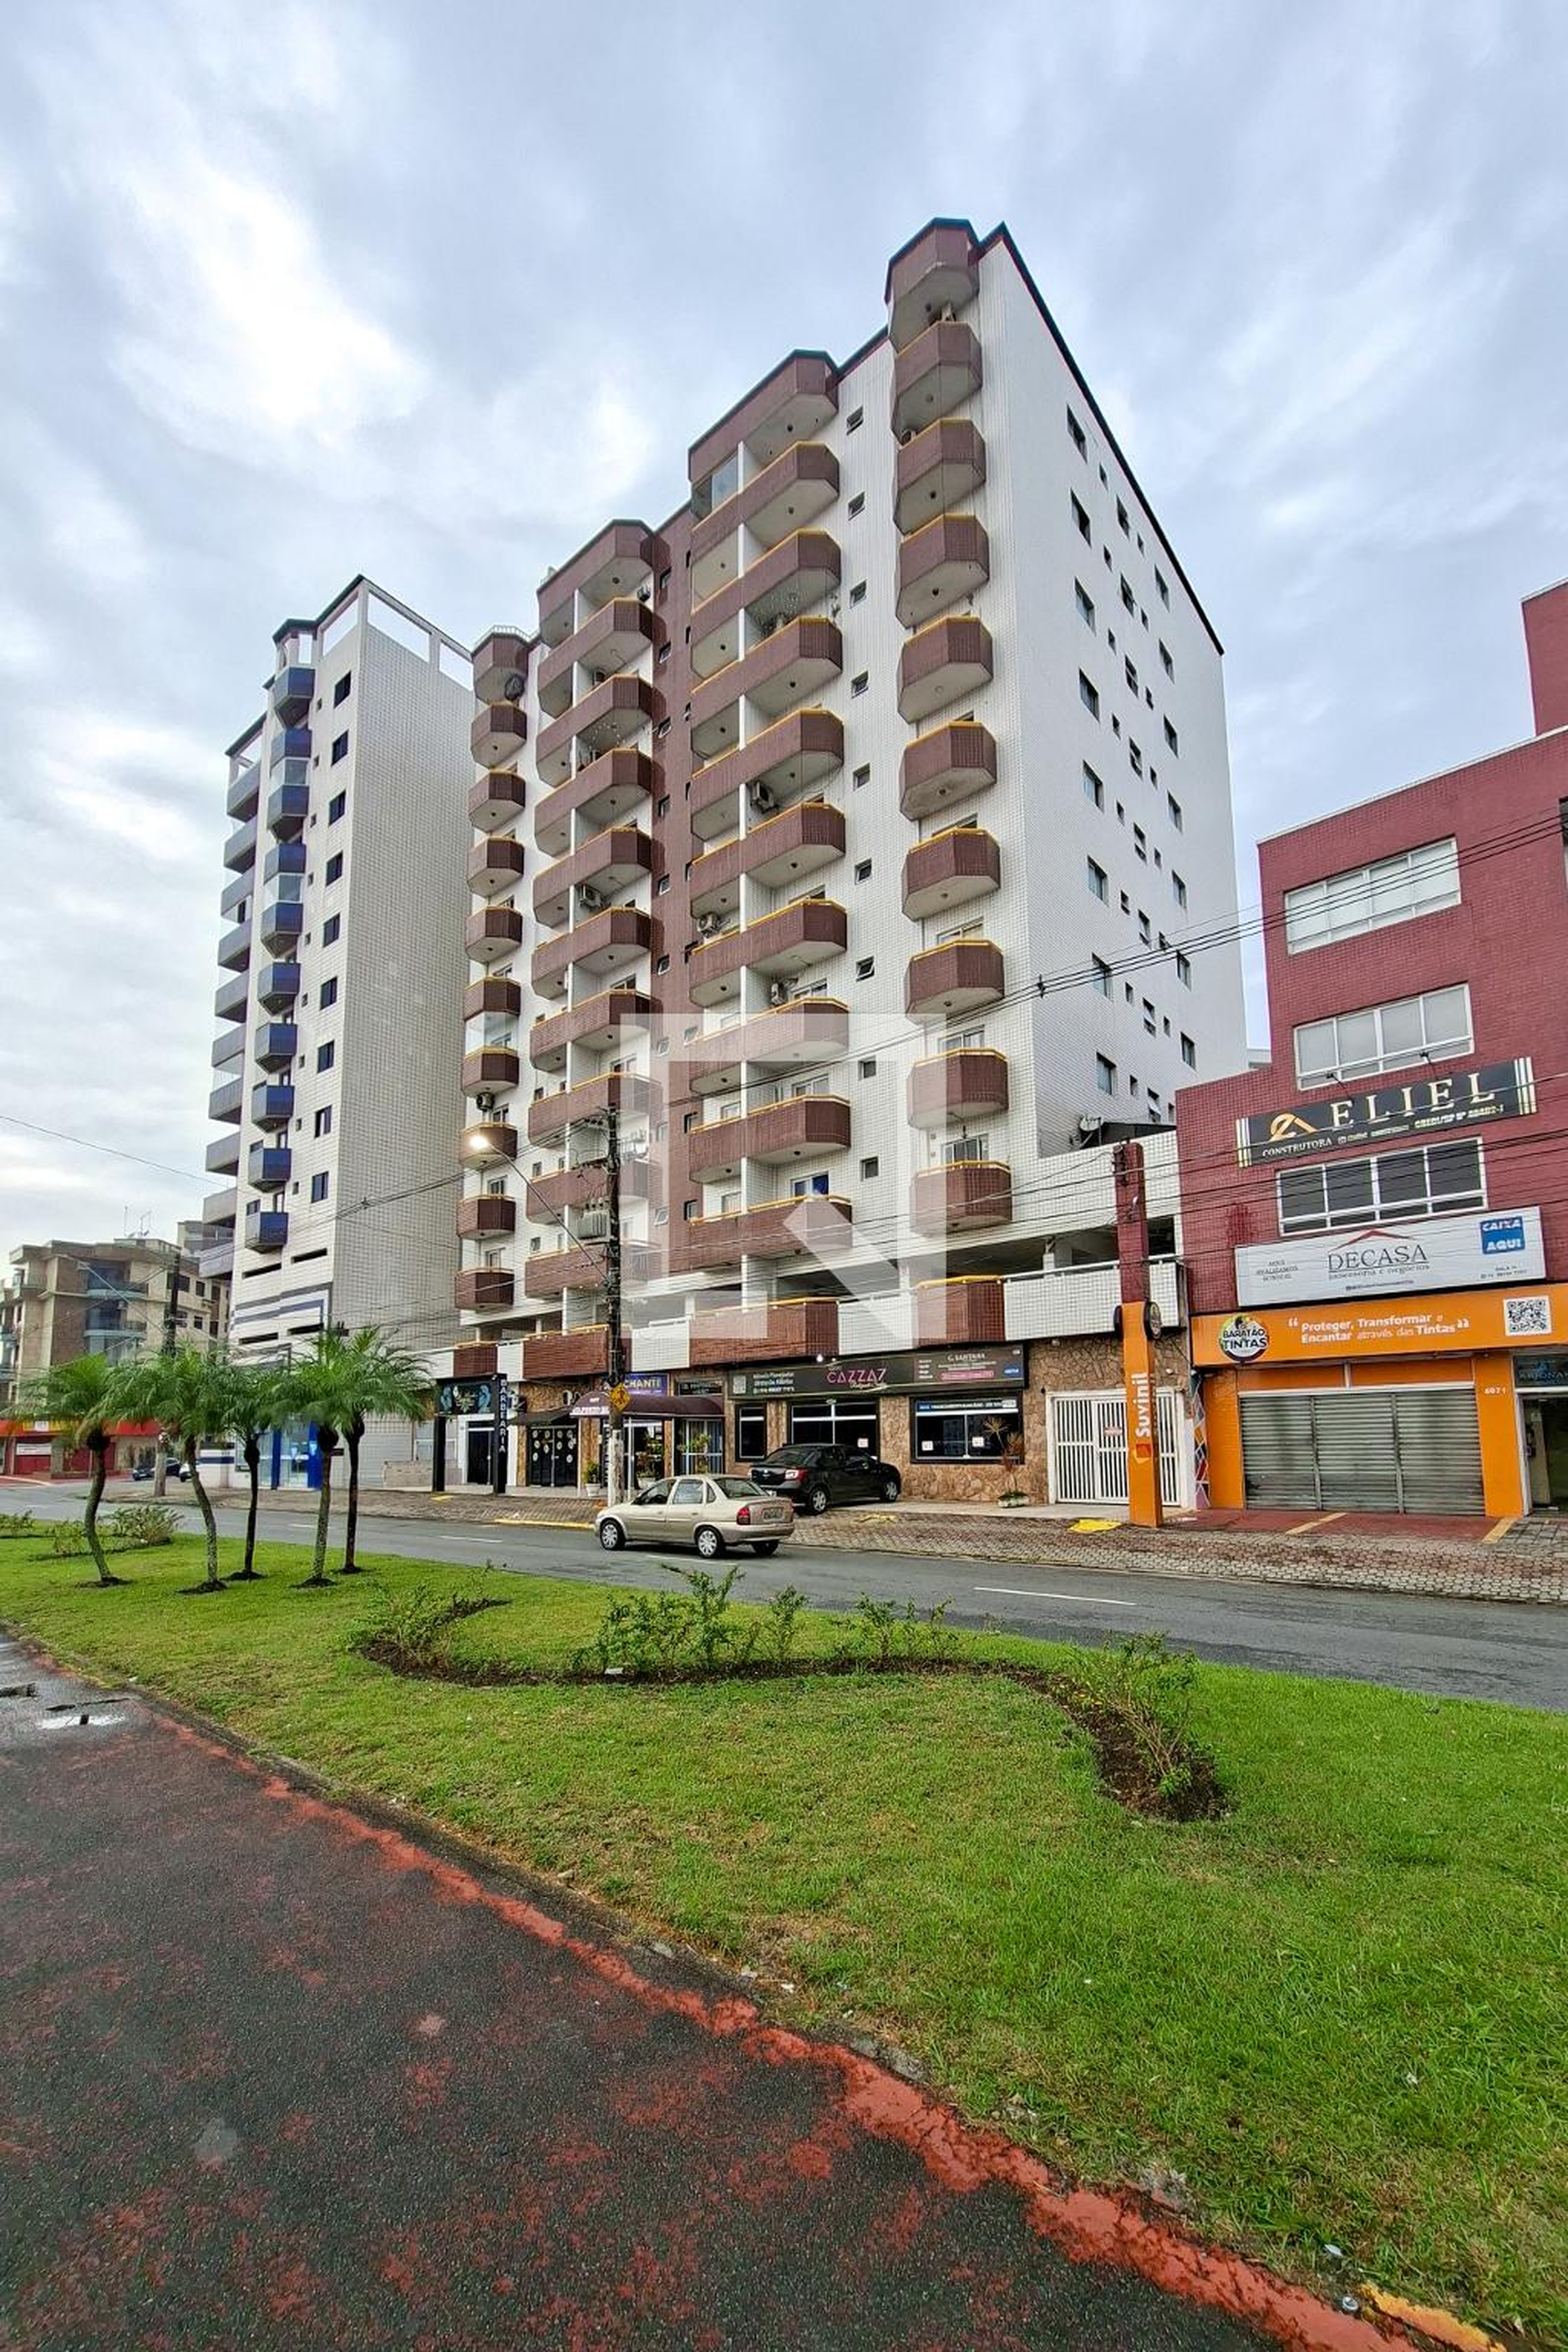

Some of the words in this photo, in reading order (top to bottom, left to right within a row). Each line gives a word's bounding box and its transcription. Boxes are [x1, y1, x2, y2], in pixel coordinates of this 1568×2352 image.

[1330, 1072, 1495, 1131] ELIEL
[1262, 1136, 1333, 1157] CONSTRUTORA
[1482, 1219, 1521, 1232] CAIXA
[1486, 1238, 1522, 1251] AQUI
[1327, 1244, 1428, 1271] DECASA
[1223, 1325, 1265, 1338] BARATÃO
[1357, 1314, 1432, 1328] Transformar
[1223, 1337, 1267, 1350] TINTAS
[1301, 1331, 1352, 1344] Encantar
[1396, 1325, 1414, 1337] das
[1415, 1323, 1456, 1335] Tintas
[1131, 1372, 1151, 1438] Suvinil
[499, 1379, 507, 1453] BARBEARIA
